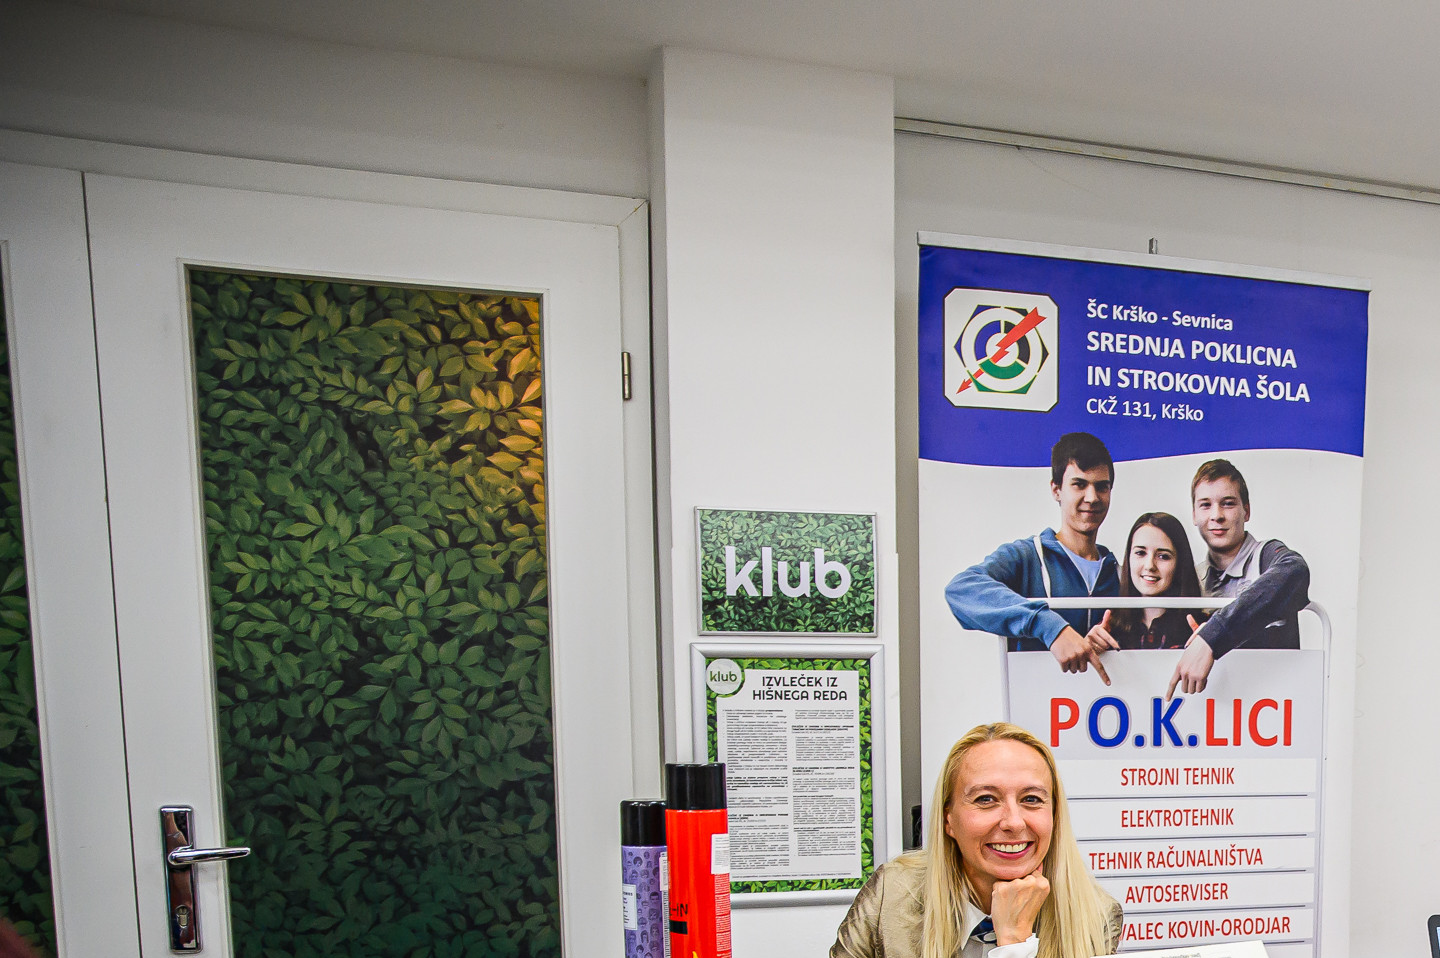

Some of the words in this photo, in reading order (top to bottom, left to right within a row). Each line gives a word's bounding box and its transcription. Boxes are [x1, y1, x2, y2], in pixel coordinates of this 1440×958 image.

[1086, 298, 1109, 319] ŠC
[1112, 304, 1158, 324] Krško
[1172, 310, 1233, 331] Sevnica
[1086, 331, 1186, 361] SREDNJA
[1191, 339, 1297, 369] POKLICNA
[1086, 366, 1111, 387] IN
[1117, 368, 1251, 399] STROKOVNA
[1256, 373, 1310, 403] ŠOLA
[1086, 396, 1117, 417] CKŽ
[1122, 401, 1157, 421] 131,
[1161, 403, 1204, 422] Krško
[725, 545, 851, 599] klub
[709, 670, 738, 682] klub
[762, 673, 822, 687] IZVLEČEK
[826, 676, 838, 687] IZ
[752, 686, 809, 701] HIŠNEGA
[814, 690, 848, 701] REDA
[1120, 767, 1180, 787] STROJNI
[1183, 766, 1235, 786] TEHNIK
[1121, 807, 1234, 828] ELEKTROTEHNIK
[1089, 851, 1142, 871] TEHNIK
[1147, 843, 1264, 869] RAČUNALNIŠTVA
[1125, 882, 1229, 904] AVTOSERVISER
[1168, 916, 1291, 939] KOVIN-ORODJAR
